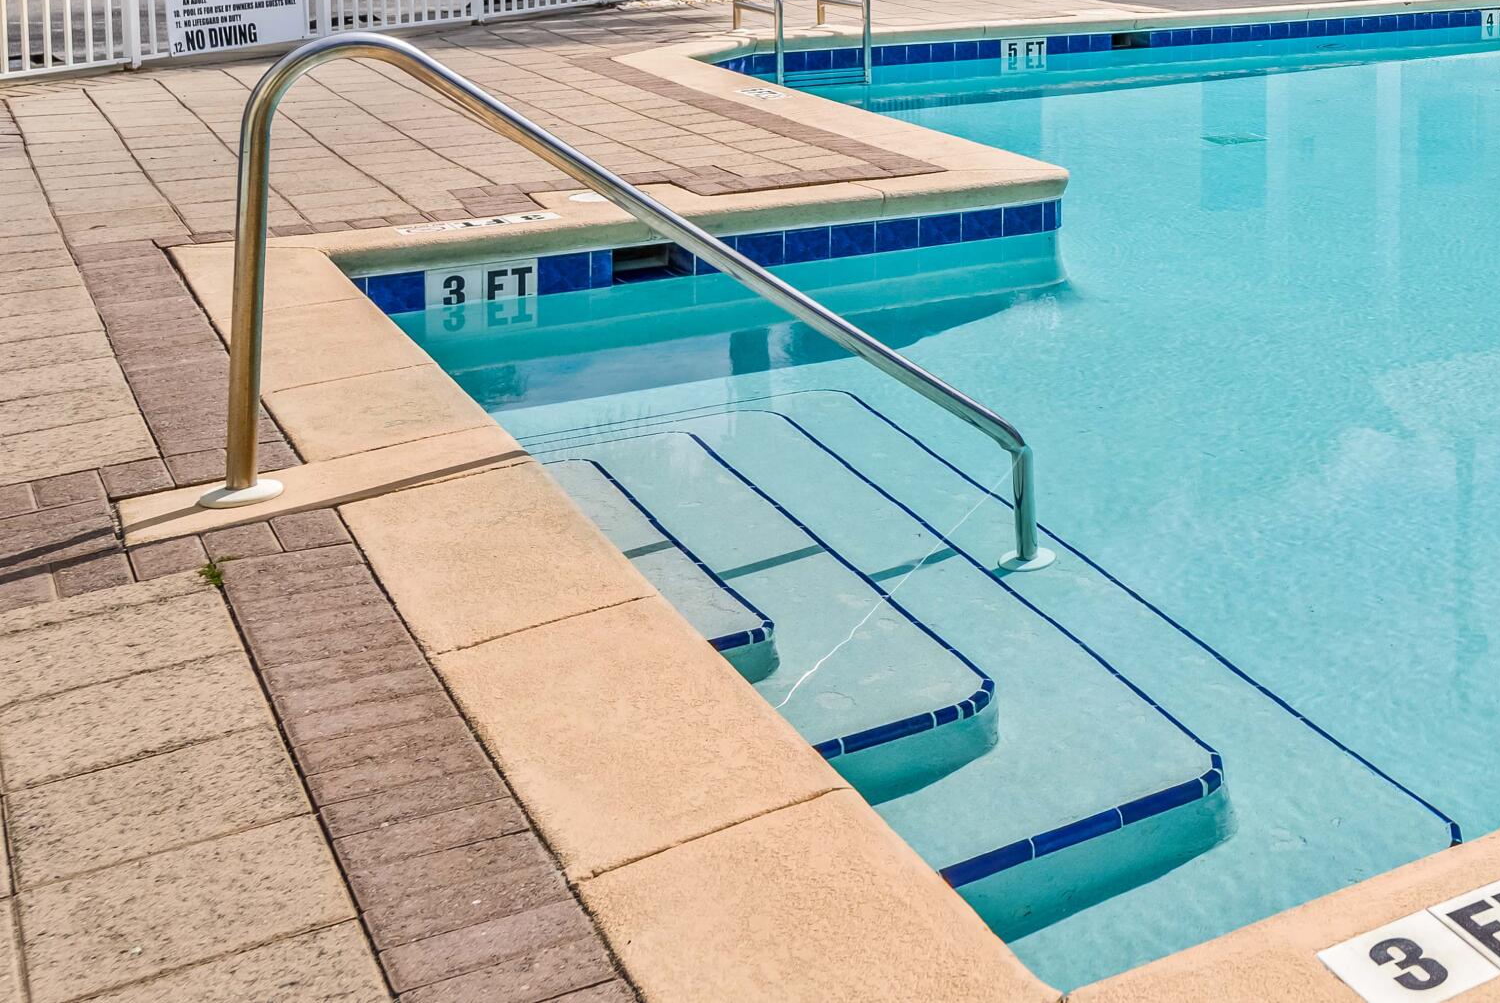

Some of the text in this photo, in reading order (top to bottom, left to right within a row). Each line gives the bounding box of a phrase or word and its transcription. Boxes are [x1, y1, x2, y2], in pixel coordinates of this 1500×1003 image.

[183, 7, 196, 17] POOL
[197, 7, 203, 15] IS
[204, 6, 213, 15] FOR
[214, 5, 224, 13] USE
[225, 4, 231, 12] BY
[232, 2, 253, 11] OWNERS
[254, 0, 264, 9] AND
[184, 19, 191, 27] NO
[192, 16, 220, 26] LIFEGUARD
[220, 15, 228, 23] ON
[228, 13, 242, 23] DUTY
[1486, 12, 1494, 26] 4
[174, 22, 258, 53] 12. NO DIVING
[1008, 41, 1045, 58] 5 FT
[442, 274, 466, 306] 3
[1368, 937, 1449, 991] 3
